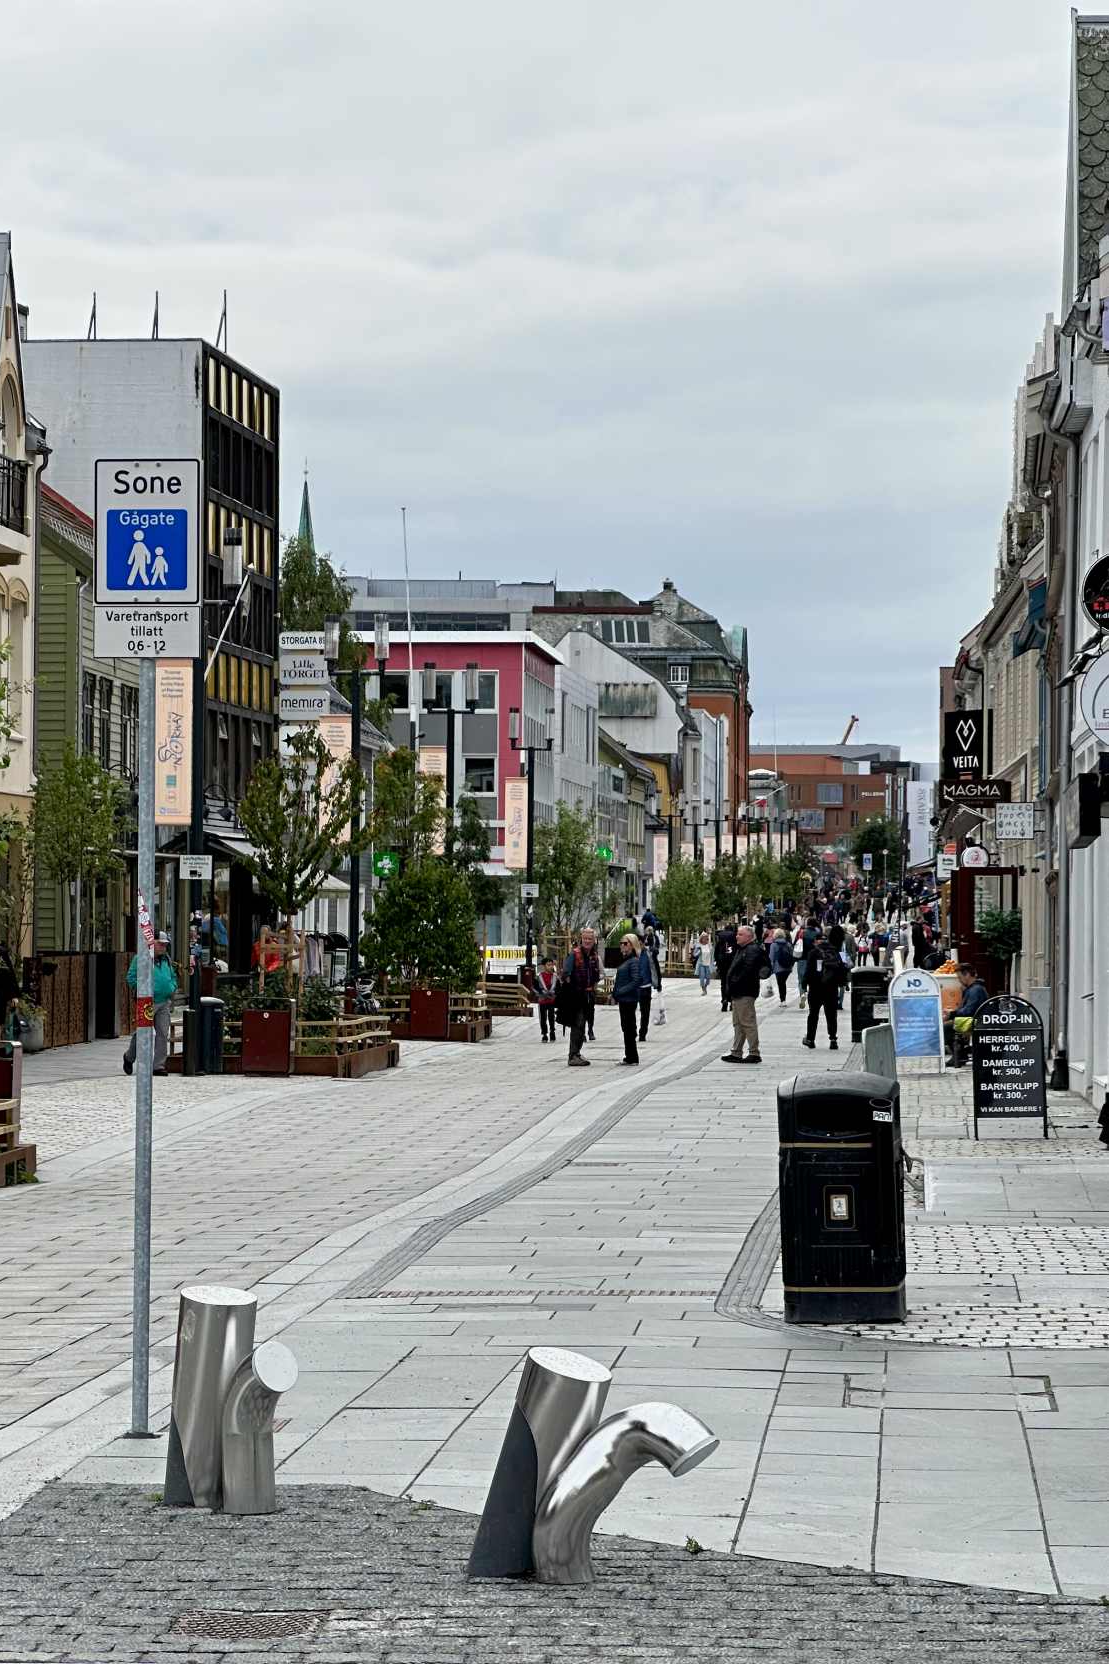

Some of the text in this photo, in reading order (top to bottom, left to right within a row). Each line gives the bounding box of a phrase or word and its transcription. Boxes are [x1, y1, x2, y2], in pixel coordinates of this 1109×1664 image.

[113, 470, 182, 494] Sone
[119, 510, 175, 529] Gågate
[105, 611, 189, 624] Varetransport
[130, 626, 163, 637] tillatt
[281, 636, 325, 645] STORGATA 8
[293, 659, 315, 669] Lille
[283, 670, 324, 679] TORGET
[281, 698, 323, 708] memira
[952, 755, 980, 768] VEITA
[943, 784, 1001, 796] MAGMA
[982, 1014, 1033, 1024] DROP-IN
[979, 1035, 1037, 1043] HERREKLIPP
[991, 1044, 1025, 1052] kr. 400,-
[982, 1059, 1035, 1067] DAMEKLIPP
[992, 1068, 1026, 1076] kr. 500,-
[980, 1082, 1039, 1091] BARNEKLIPP
[1005, 1091, 1027, 1100] 300,-
